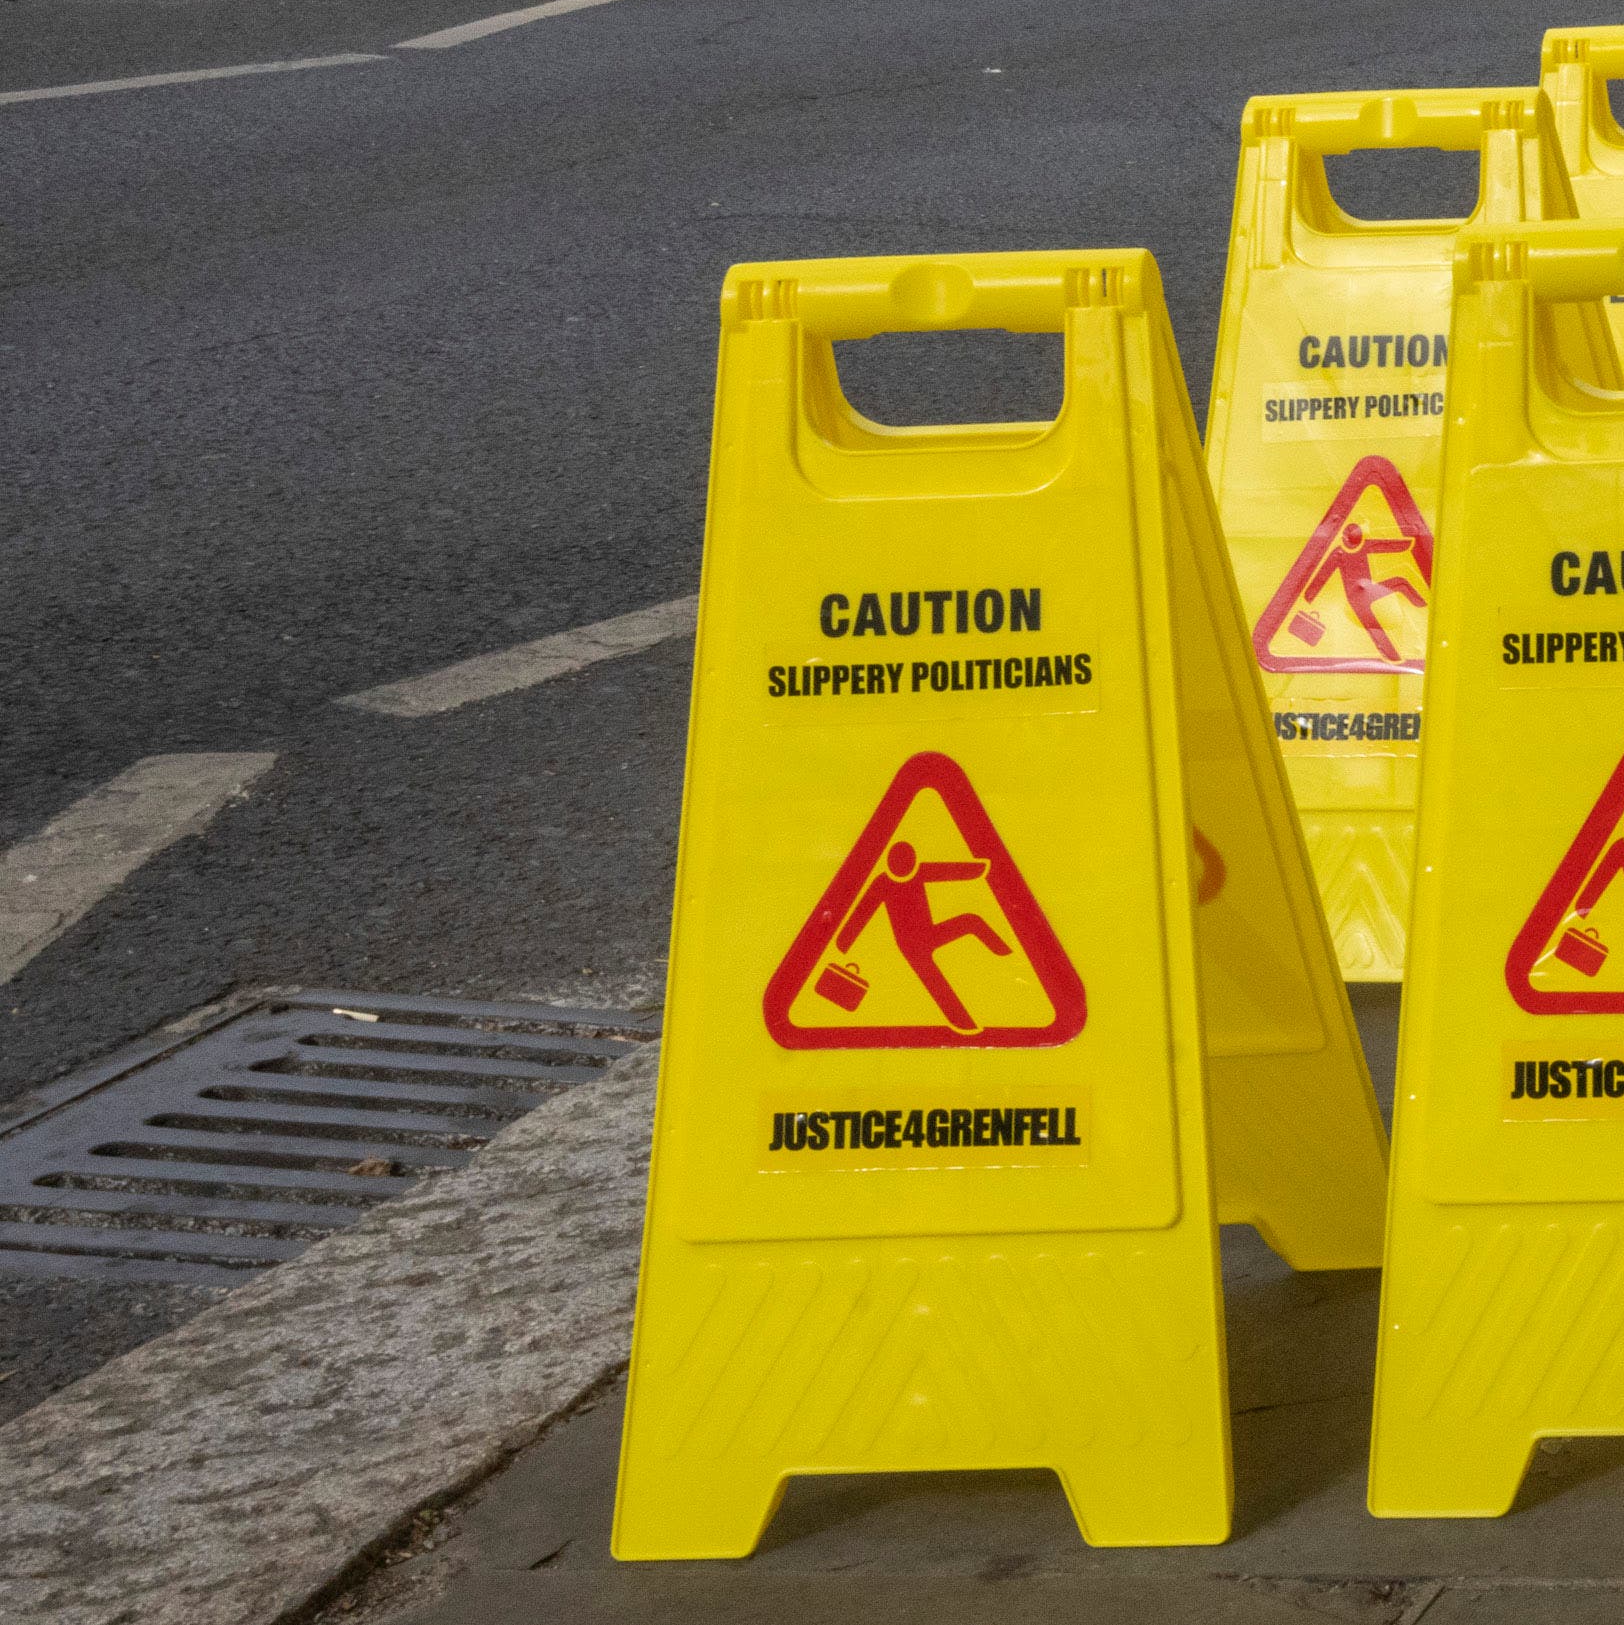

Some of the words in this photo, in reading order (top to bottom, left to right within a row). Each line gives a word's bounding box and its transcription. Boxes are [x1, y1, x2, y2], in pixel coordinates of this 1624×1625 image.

[1264, 391, 1360, 423] SLIPPERY
[1364, 389, 1445, 419] POLITIC
[820, 589, 1040, 637] CAUTION
[769, 664, 903, 697] SLIPPERY
[912, 654, 1091, 692] POLITICIANS
[770, 1108, 1080, 1150] JUSTICE4GRENFELL
